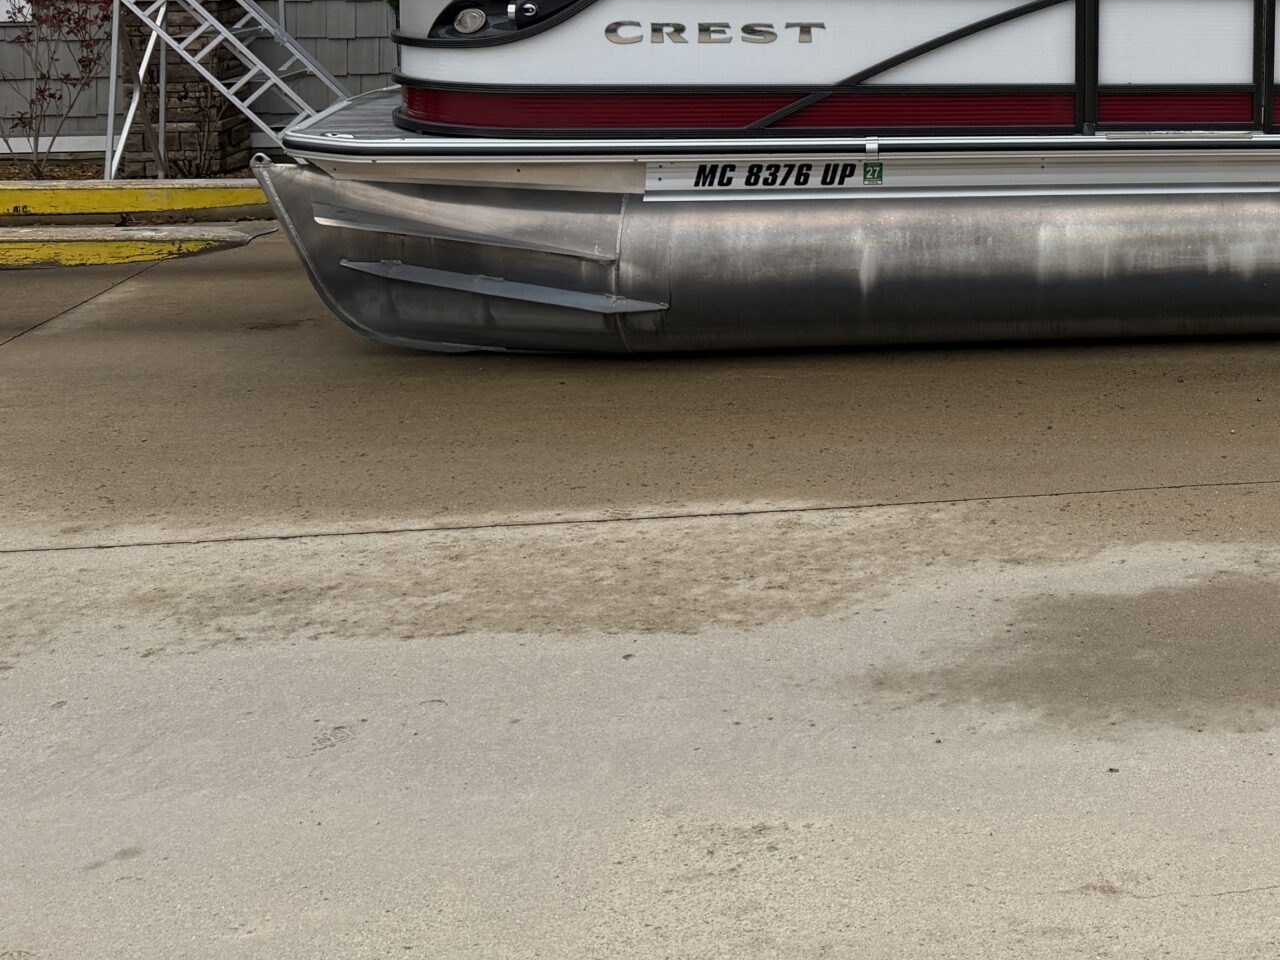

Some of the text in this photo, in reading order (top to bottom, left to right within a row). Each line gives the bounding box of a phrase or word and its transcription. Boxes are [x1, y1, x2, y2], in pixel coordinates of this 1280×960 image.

[604, 21, 826, 45] CREST
[694, 163, 857, 187] MC 8376 UP
[866, 166, 880, 179] 27
